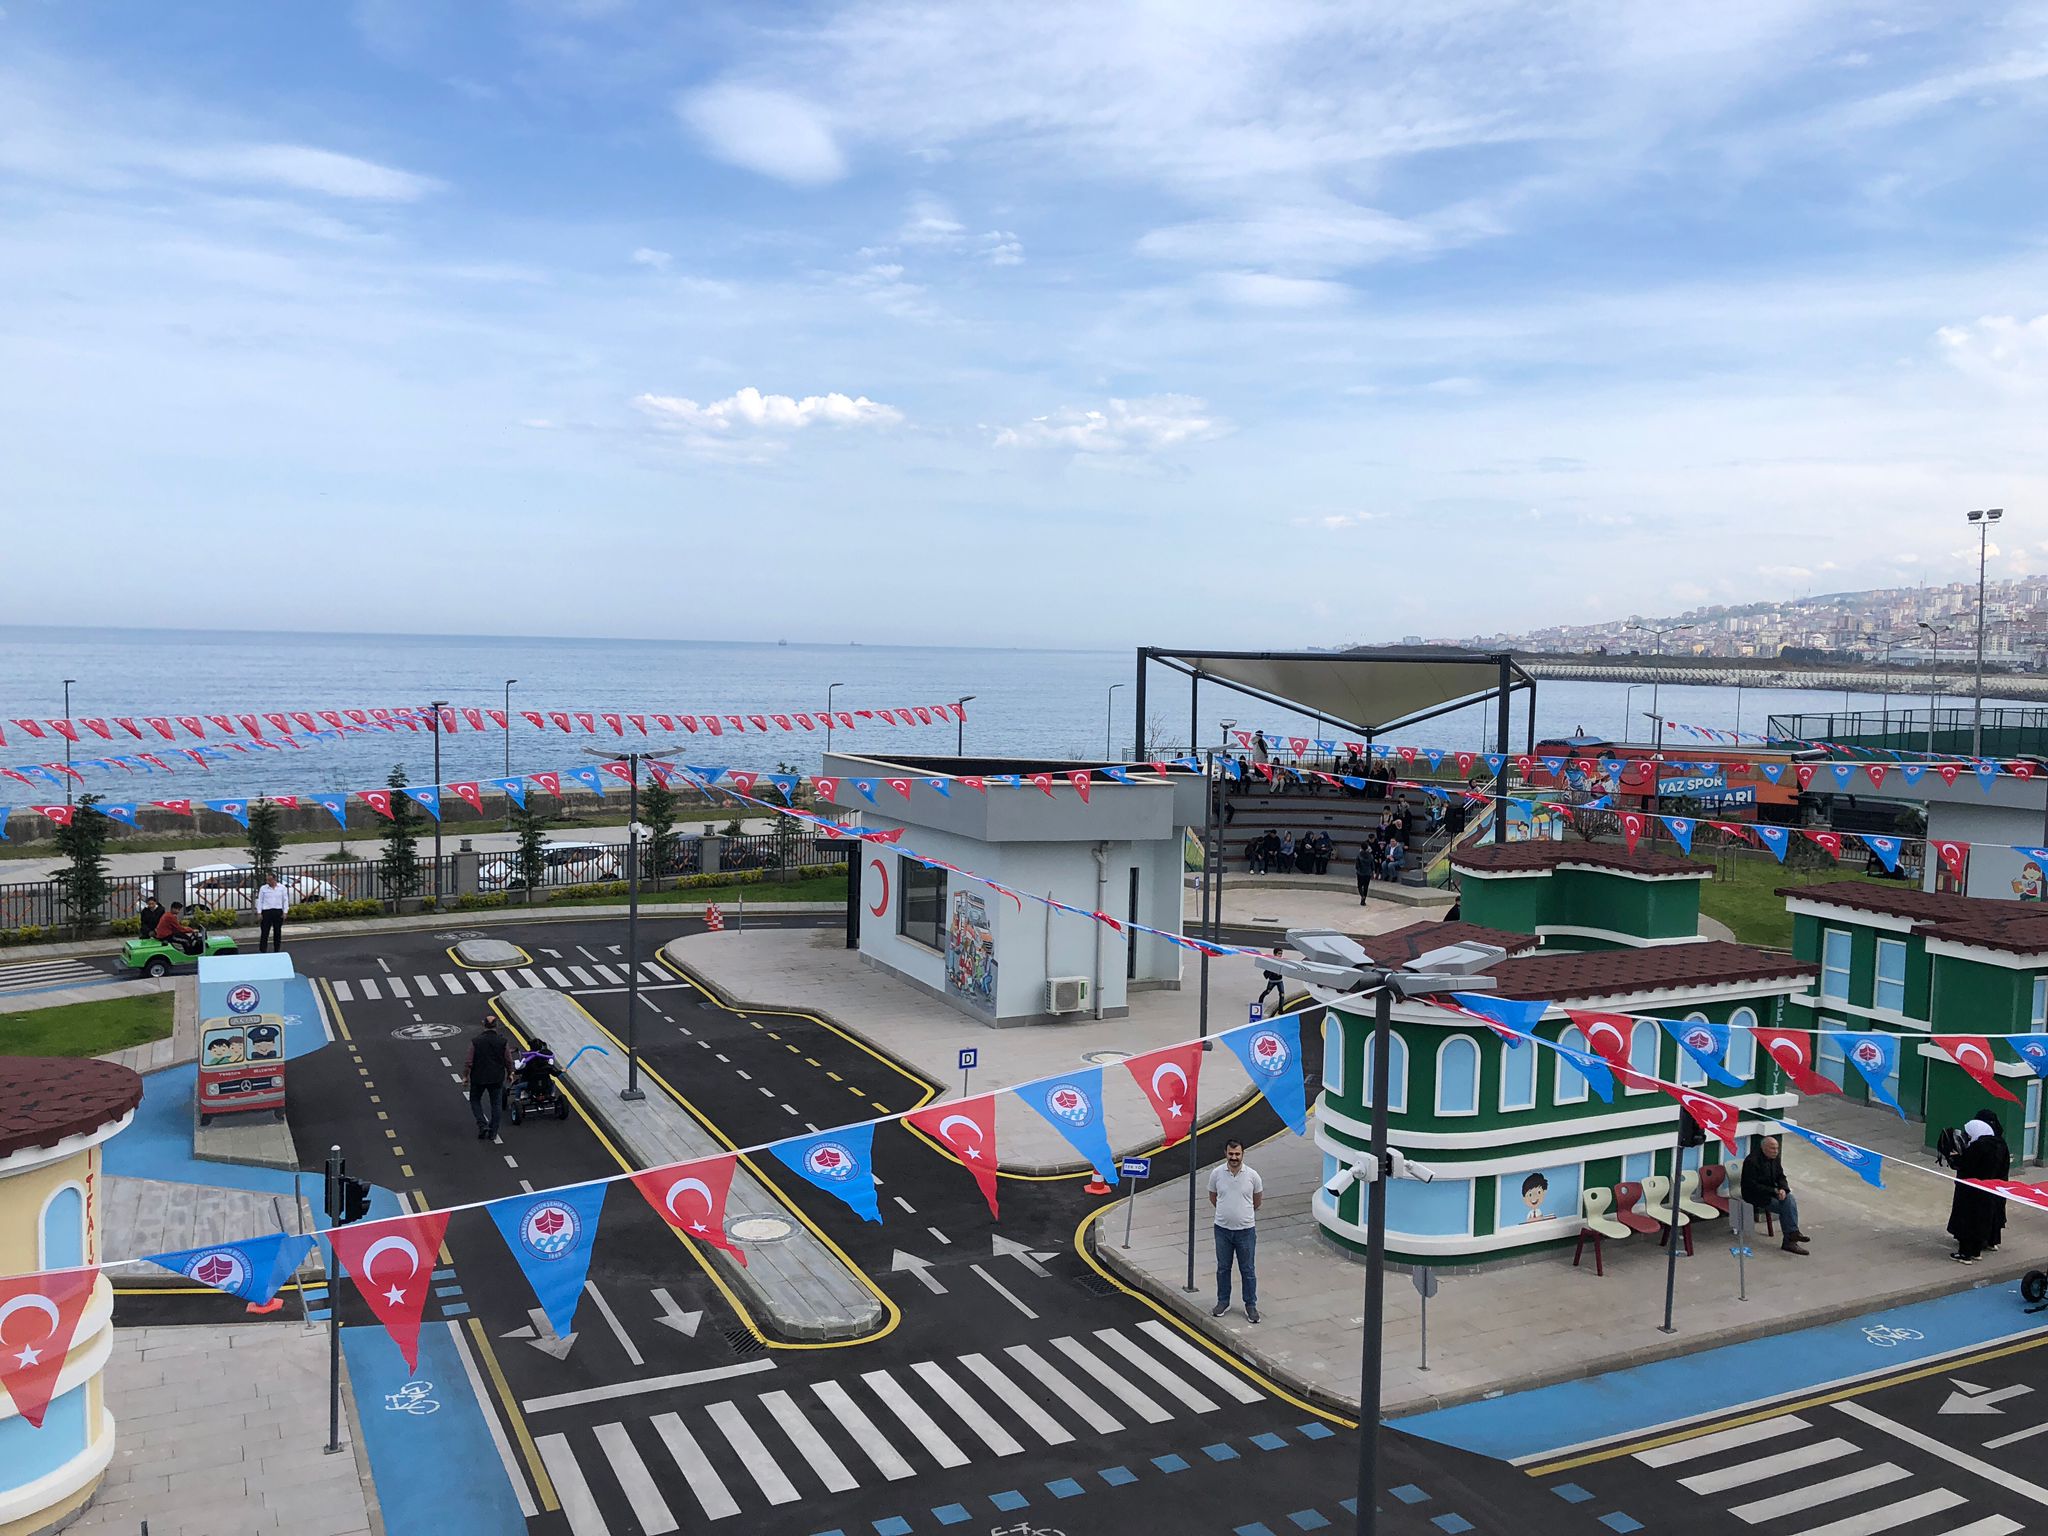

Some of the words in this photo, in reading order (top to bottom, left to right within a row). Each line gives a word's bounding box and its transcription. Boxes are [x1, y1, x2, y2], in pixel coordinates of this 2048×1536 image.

[1659, 781, 1684, 794] YAZ
[1687, 776, 1722, 791] SPOR
[964, 1053, 972, 1064] D
